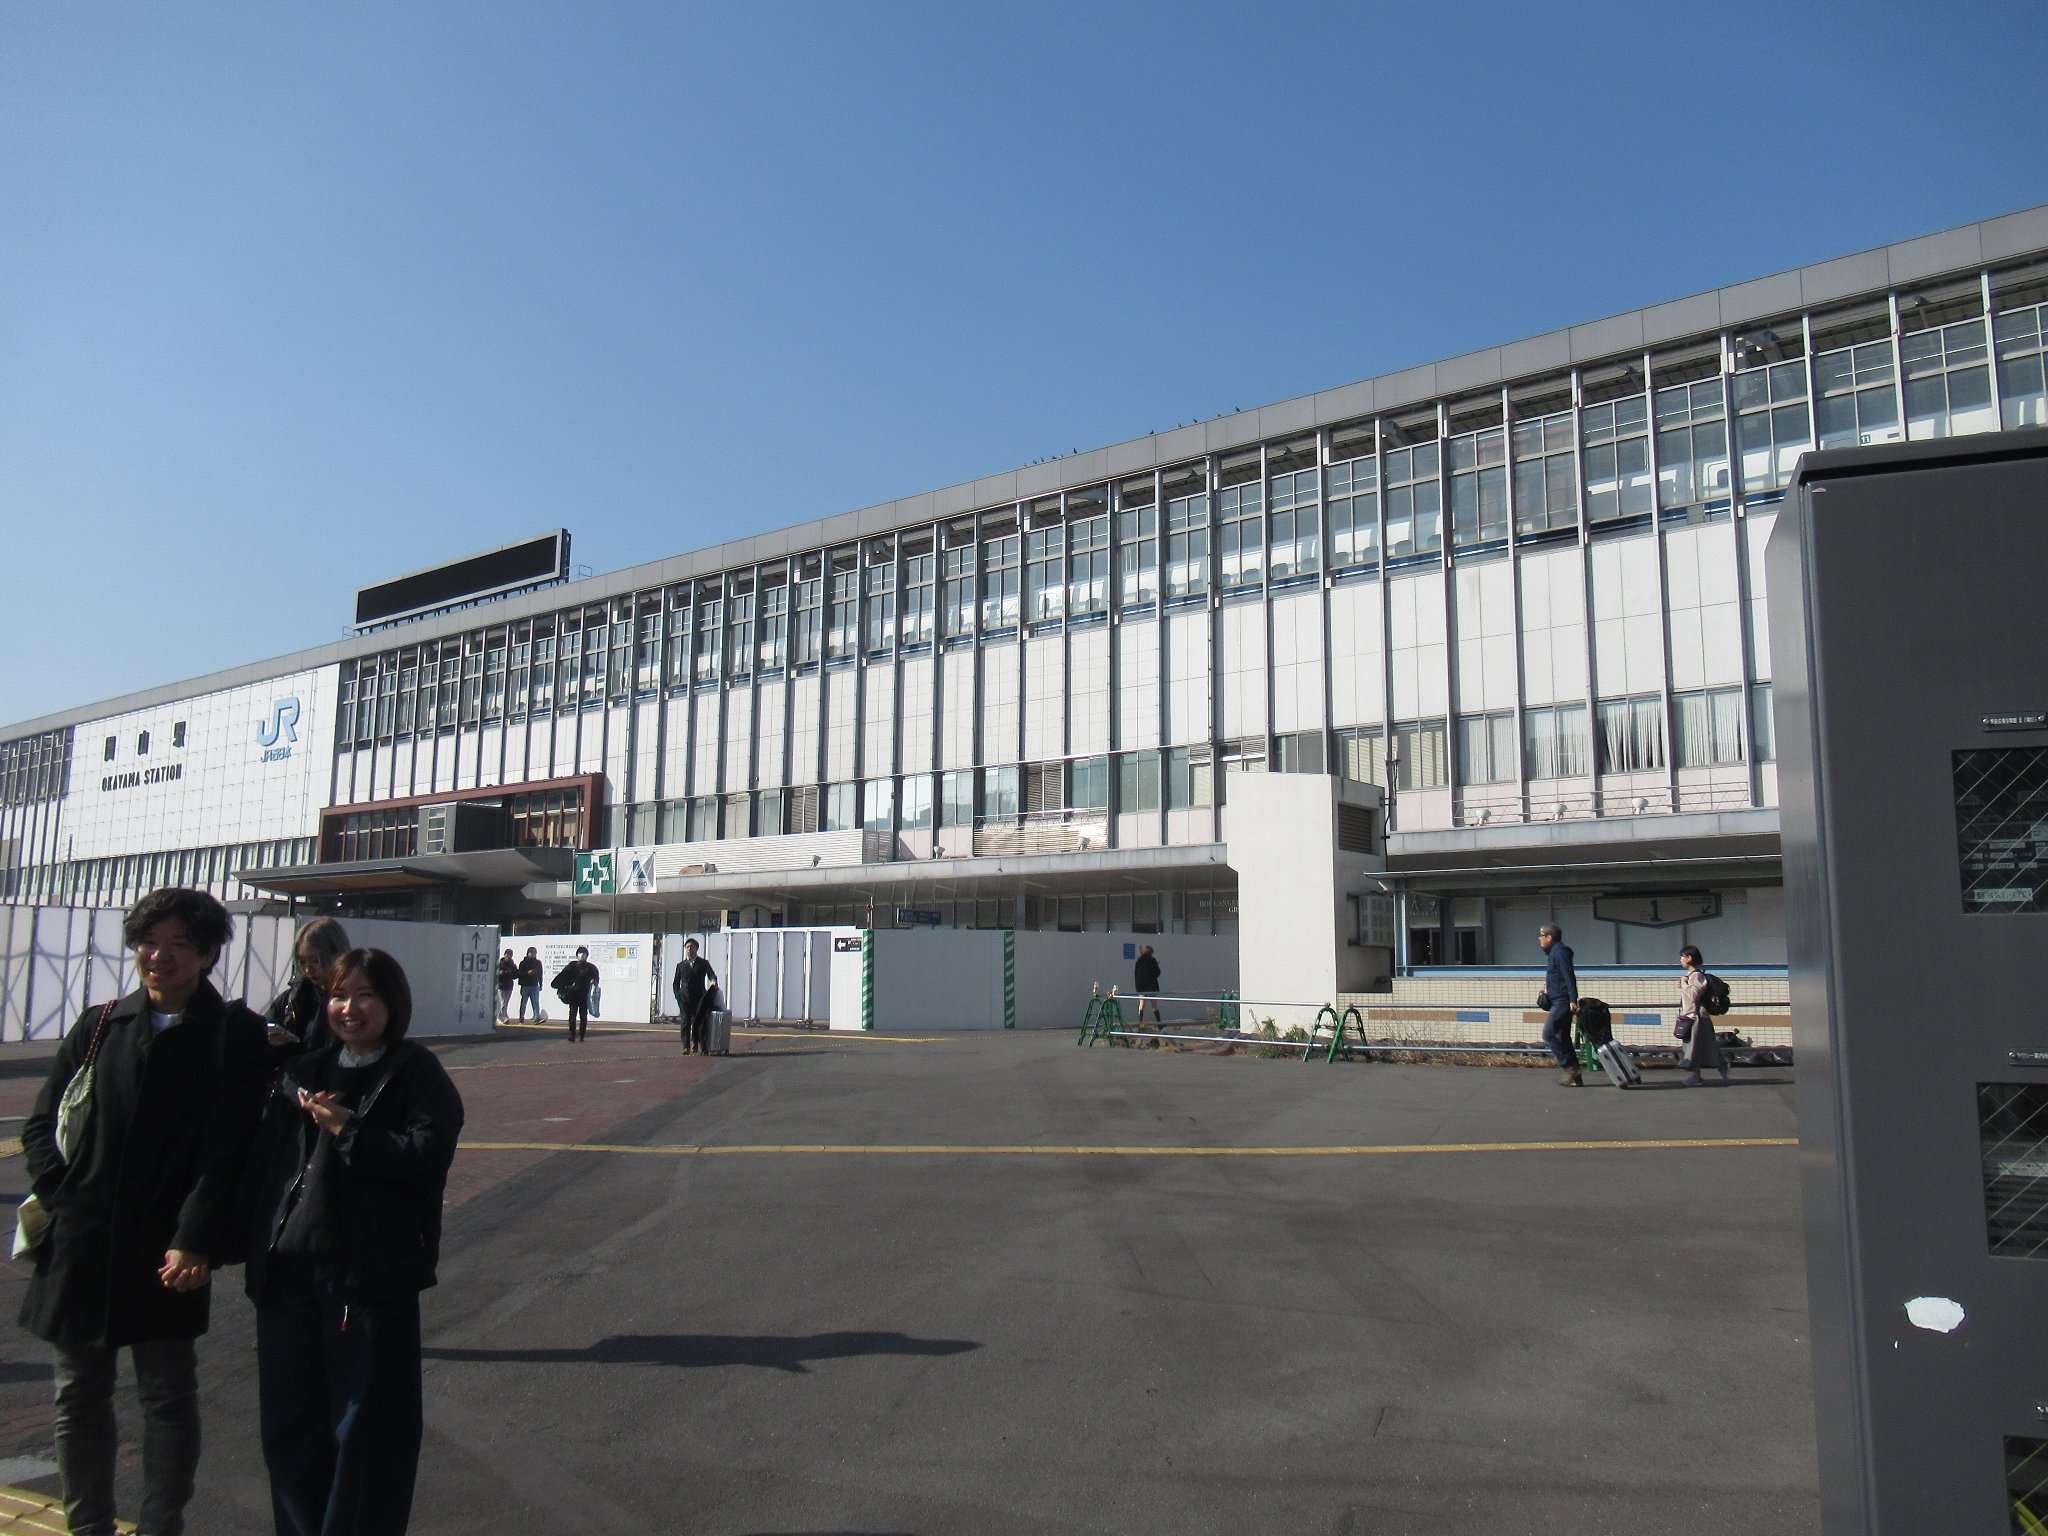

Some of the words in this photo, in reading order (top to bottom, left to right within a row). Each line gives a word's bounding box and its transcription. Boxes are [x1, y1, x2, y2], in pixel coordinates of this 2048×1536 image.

[256, 696, 300, 747] JR
[101, 771, 141, 792] OKAYAMA
[143, 763, 183, 785] STATION
[1649, 900, 1662, 922] 1
